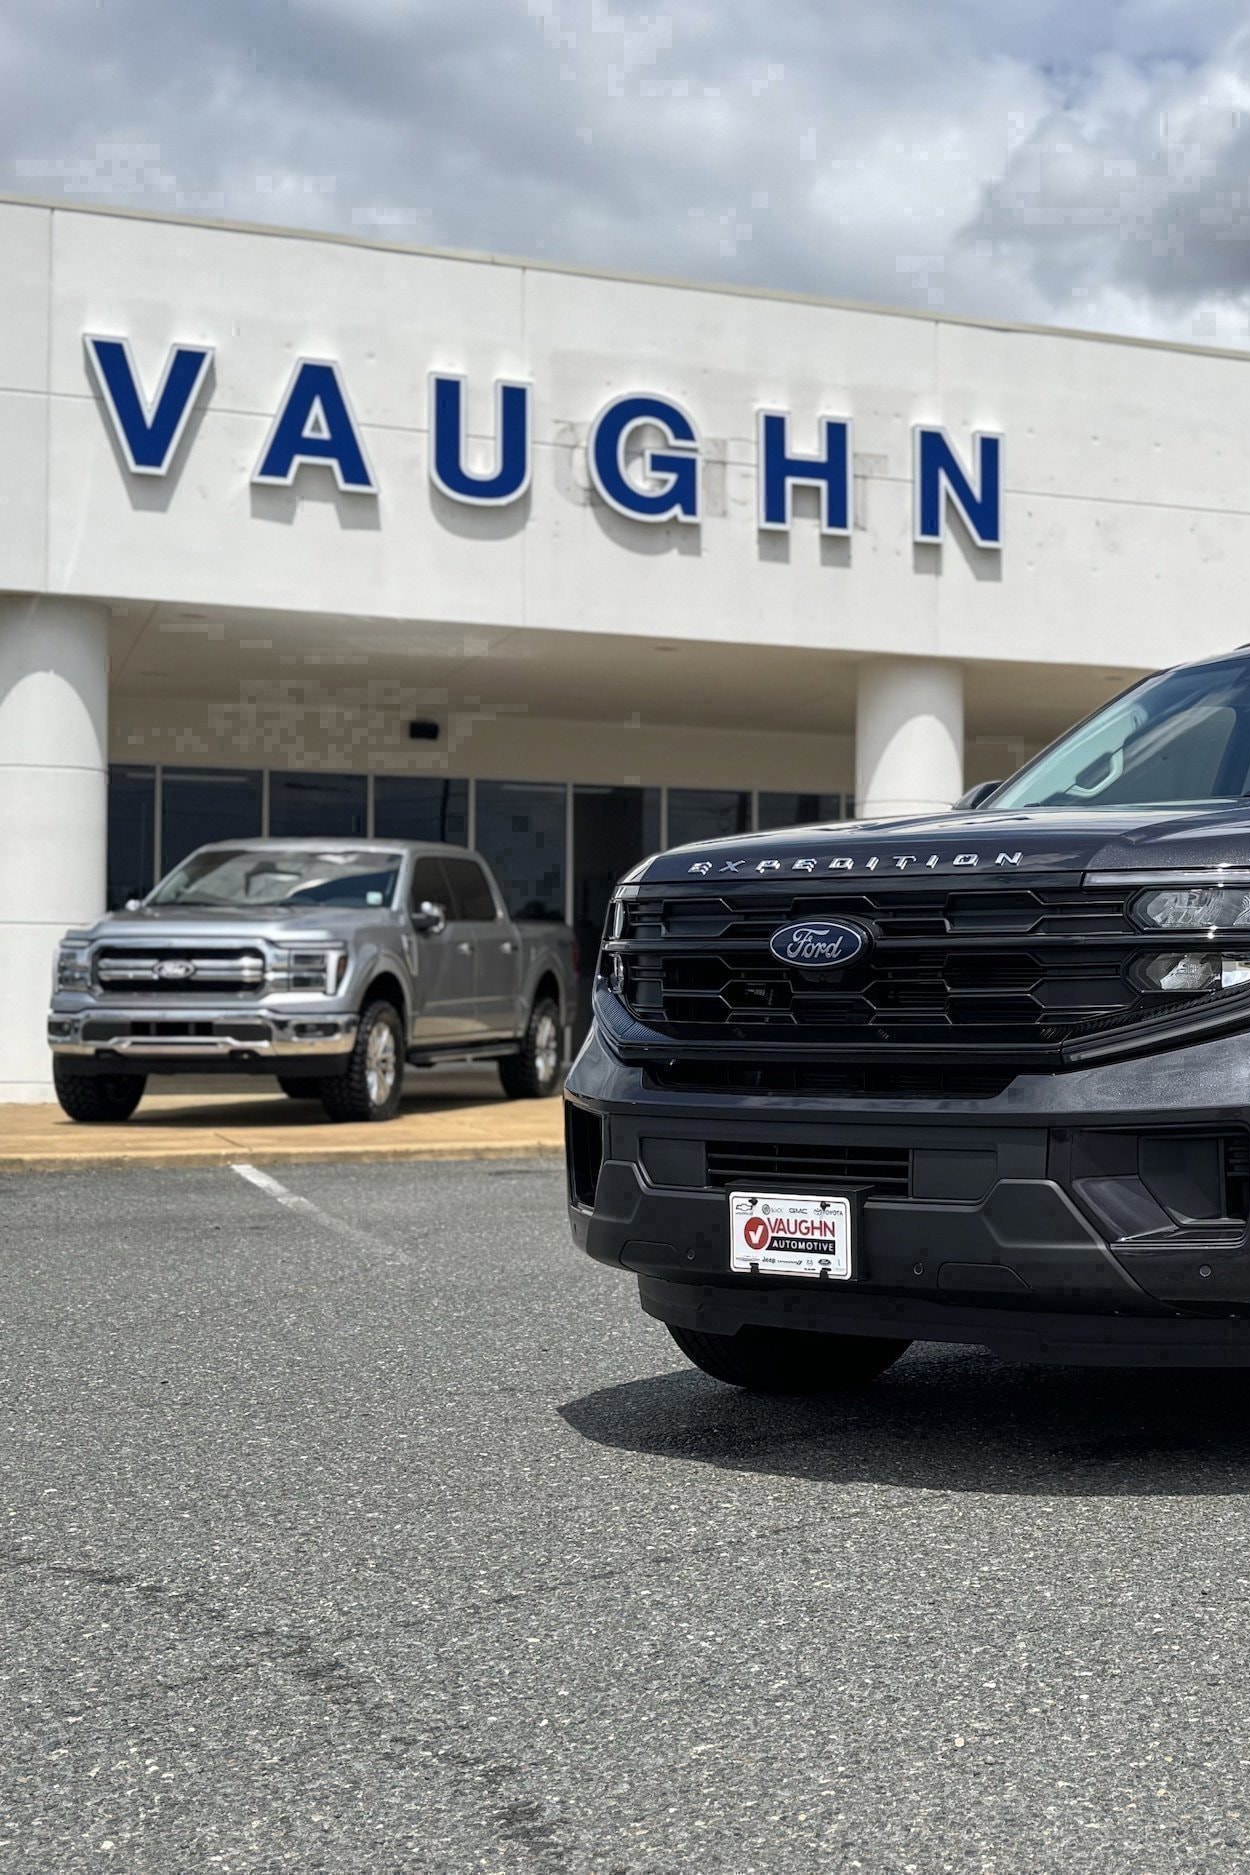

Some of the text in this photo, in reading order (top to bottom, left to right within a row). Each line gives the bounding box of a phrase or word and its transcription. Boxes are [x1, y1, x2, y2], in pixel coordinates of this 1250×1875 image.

[83, 333, 1003, 549] VAUGHN
[688, 852, 1024, 876] EXPEDITION
[786, 928, 844, 958] Ford
[767, 1218, 836, 1238] VAUGHN
[772, 1240, 834, 1252] AUTOMOTIVE
